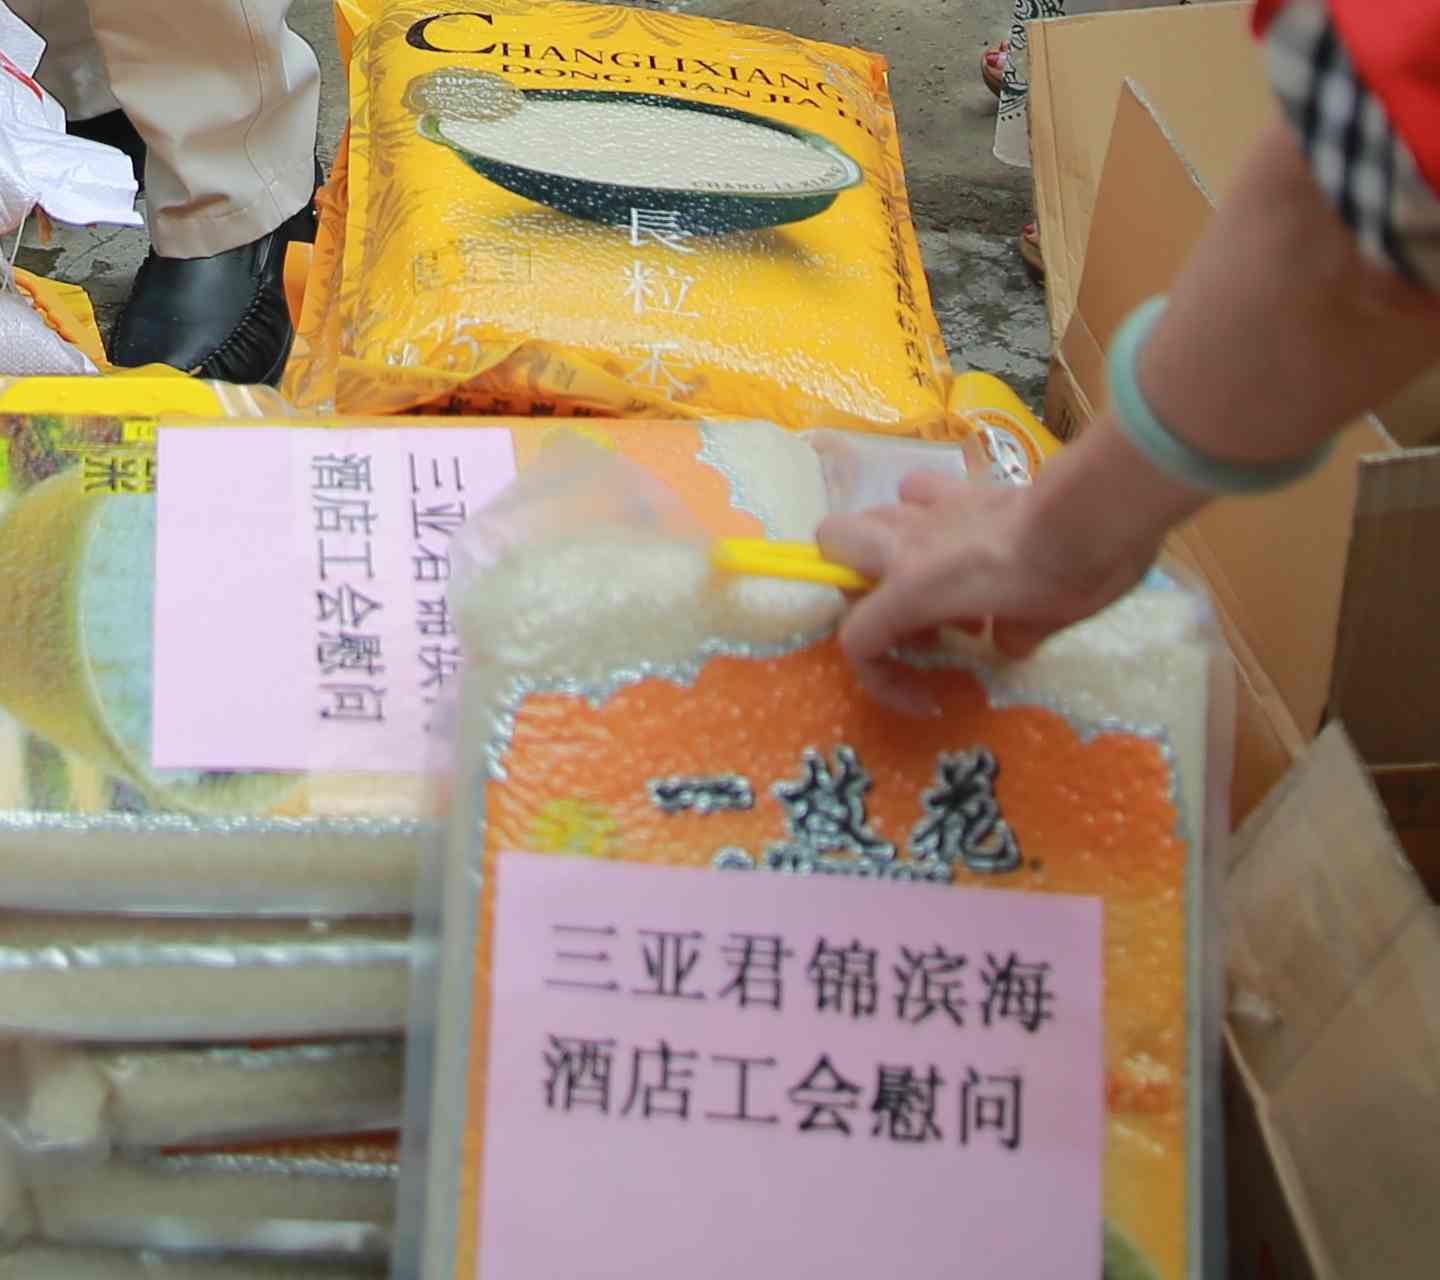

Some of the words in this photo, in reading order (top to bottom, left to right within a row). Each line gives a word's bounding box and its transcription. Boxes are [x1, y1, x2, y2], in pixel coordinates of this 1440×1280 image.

[404, 11, 846, 103] CHANGLIXIANG
[500, 63, 633, 87] DONG
[654, 75, 752, 98] TIAN
[310, 452, 387, 724] 酒店工会慰问
[646, 743, 1023, 875] 一枝花
[544, 921, 1056, 1036] 三亚君锦滨海
[540, 1034, 1028, 1152] 酒店工会慰问
